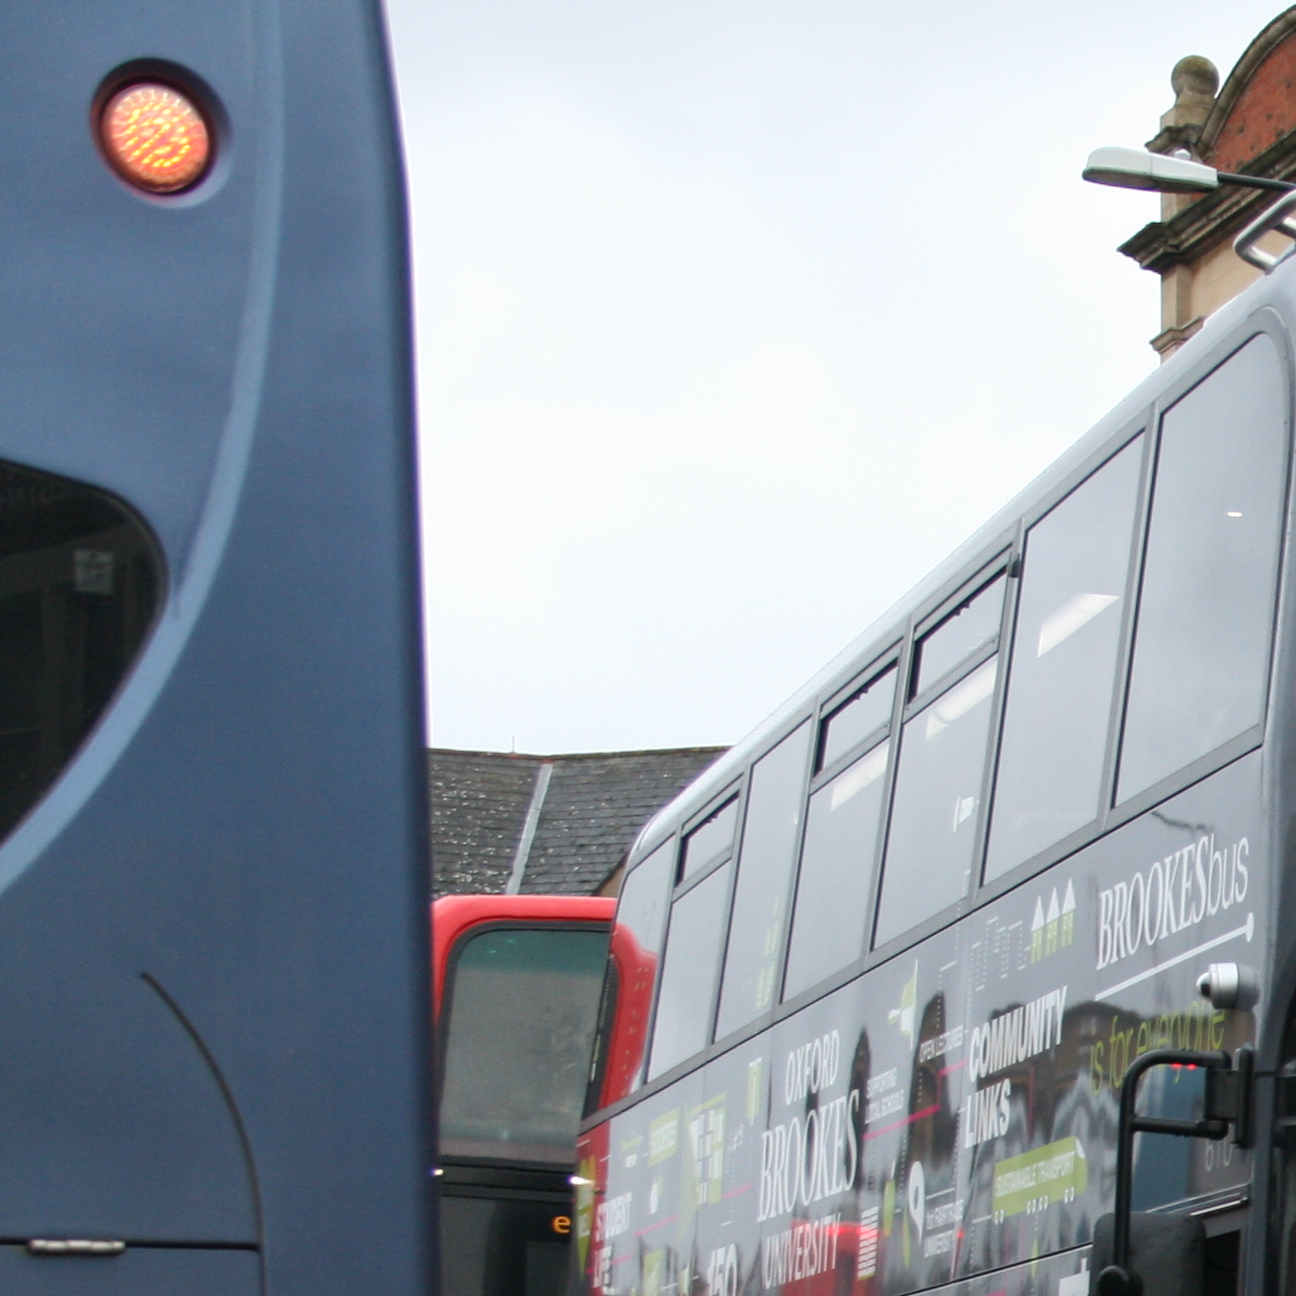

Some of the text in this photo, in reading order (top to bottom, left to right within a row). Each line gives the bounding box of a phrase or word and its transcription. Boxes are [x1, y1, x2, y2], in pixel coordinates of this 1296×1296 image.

[1096, 834, 1249, 970] BROOKESbus
[785, 1030, 839, 1105] OXFORD
[968, 985, 1068, 1083] COMMUNITY
[758, 1089, 859, 1223] BROOKES
[965, 1078, 1011, 1149] LINKS
[761, 1212, 842, 1290] UNIVERSITY
